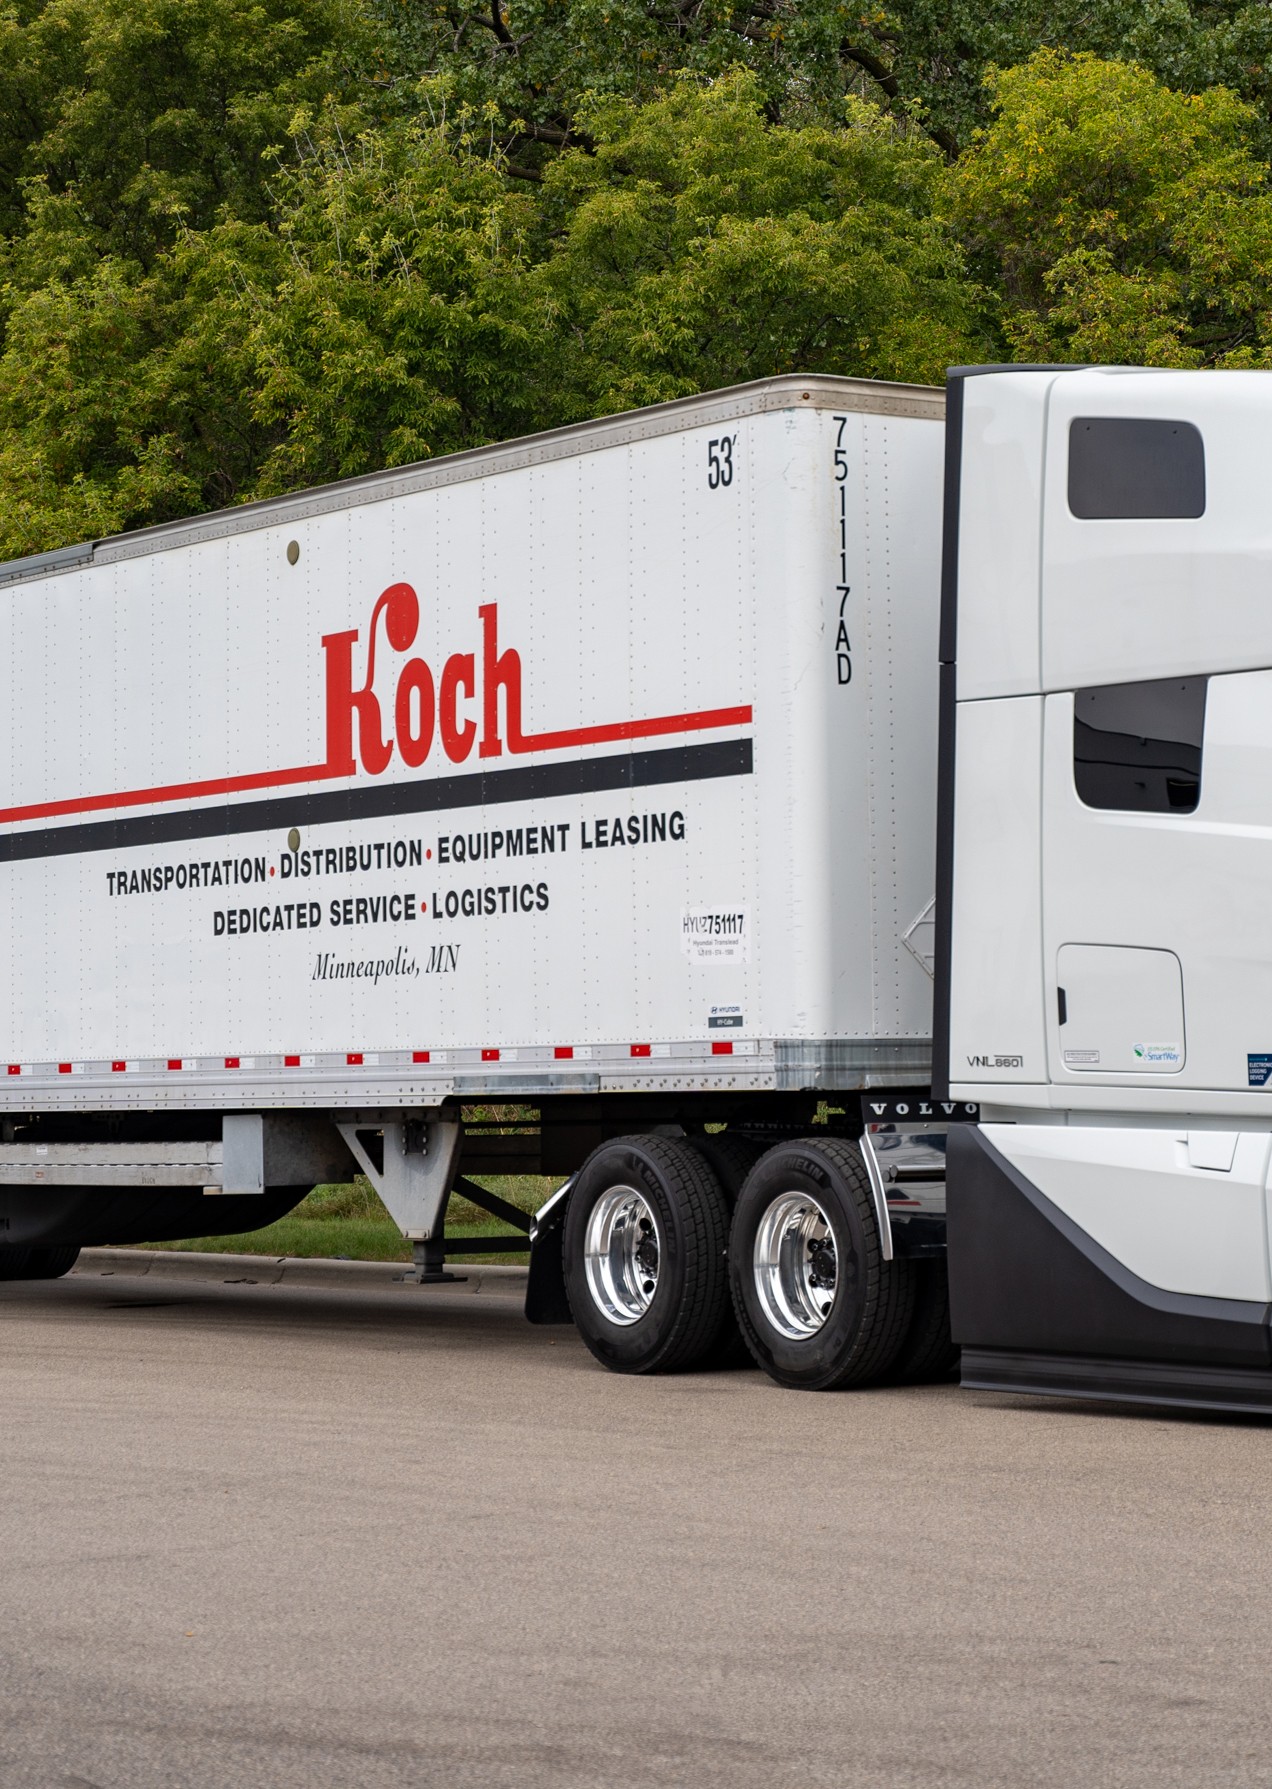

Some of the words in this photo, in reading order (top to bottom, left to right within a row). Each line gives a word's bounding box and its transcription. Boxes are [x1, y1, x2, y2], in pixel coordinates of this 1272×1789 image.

[708, 435, 737, 490] 53'
[321, 582, 522, 775] Koch
[106, 857, 266, 896] TRANSPORTATION
[280, 839, 422, 879] DISTRIBUTION
[438, 824, 570, 864] EQUIPMENT
[581, 811, 685, 850] LEASING
[213, 902, 322, 936] DEDICATED
[329, 893, 416, 927] SERVICE
[432, 882, 549, 919] LOGISTICS
[311, 945, 420, 985] Minneapolis,
[425, 944, 461, 974] MN
[870, 1103, 977, 1115] VOLVO
